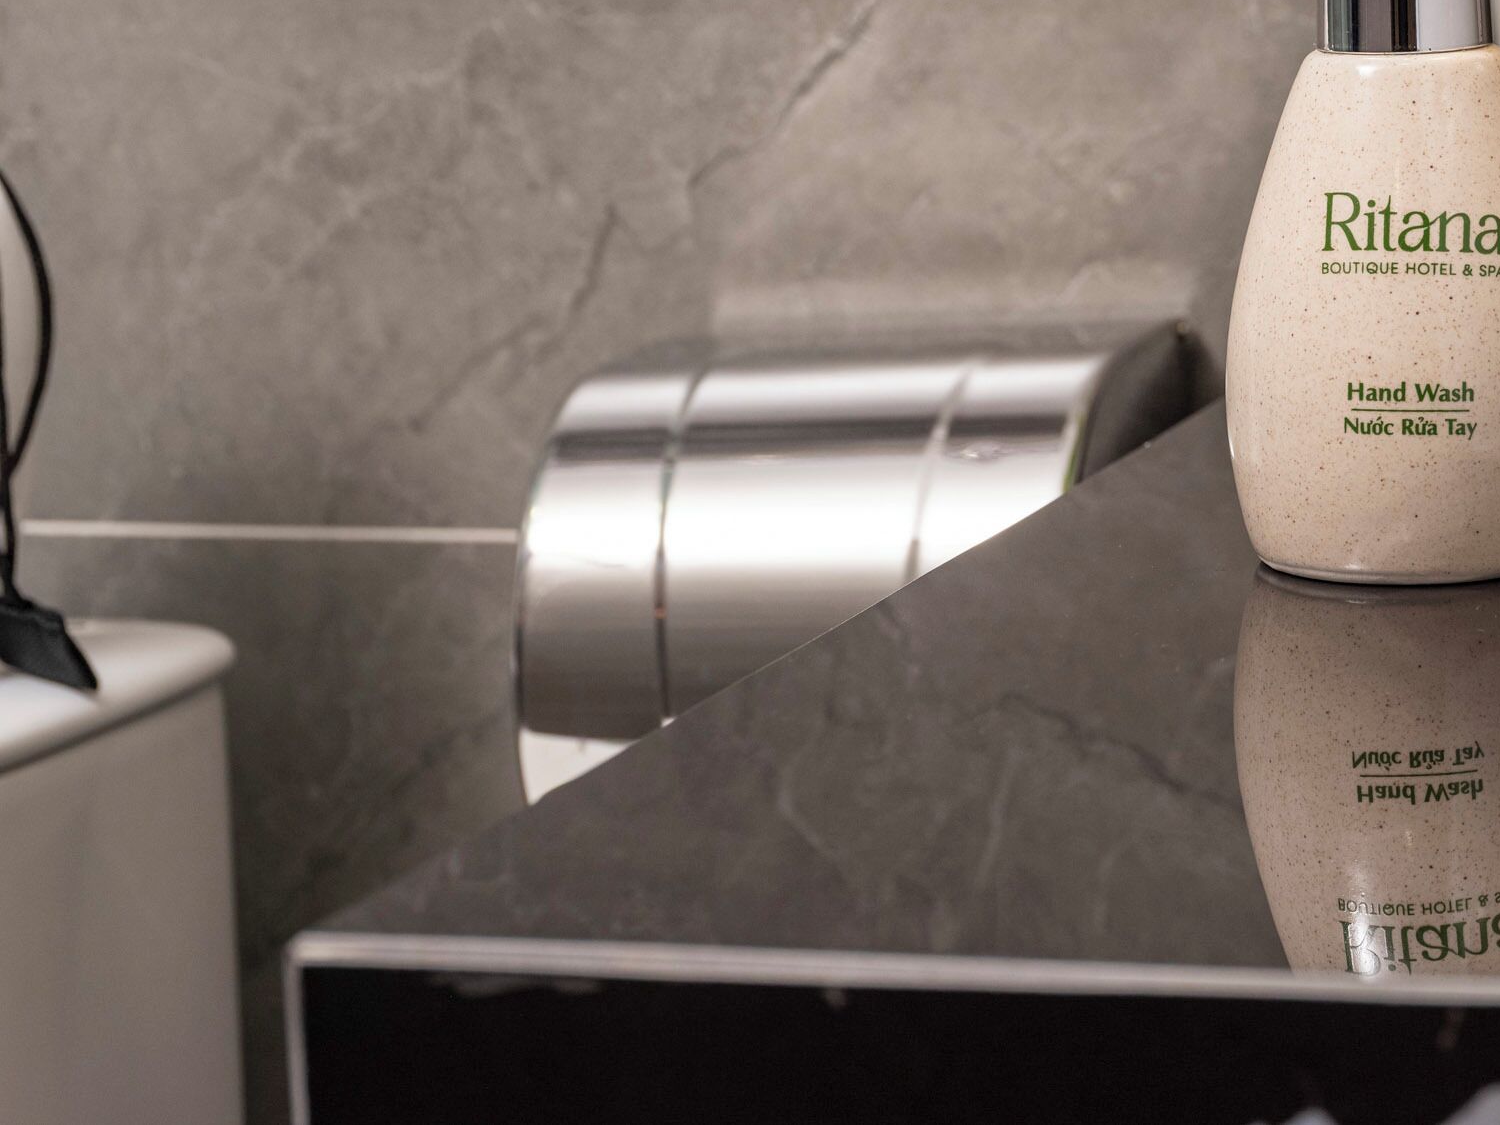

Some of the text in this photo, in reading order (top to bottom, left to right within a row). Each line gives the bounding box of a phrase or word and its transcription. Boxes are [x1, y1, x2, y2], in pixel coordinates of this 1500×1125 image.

[1321, 261, 1399, 275] BOUTIQUE
[1405, 262, 1457, 276] HOTEL
[1462, 263, 1473, 277] &
[1347, 381, 1475, 402] Hand Wash
[1343, 416, 1477, 440] Nước Rửa Tay
